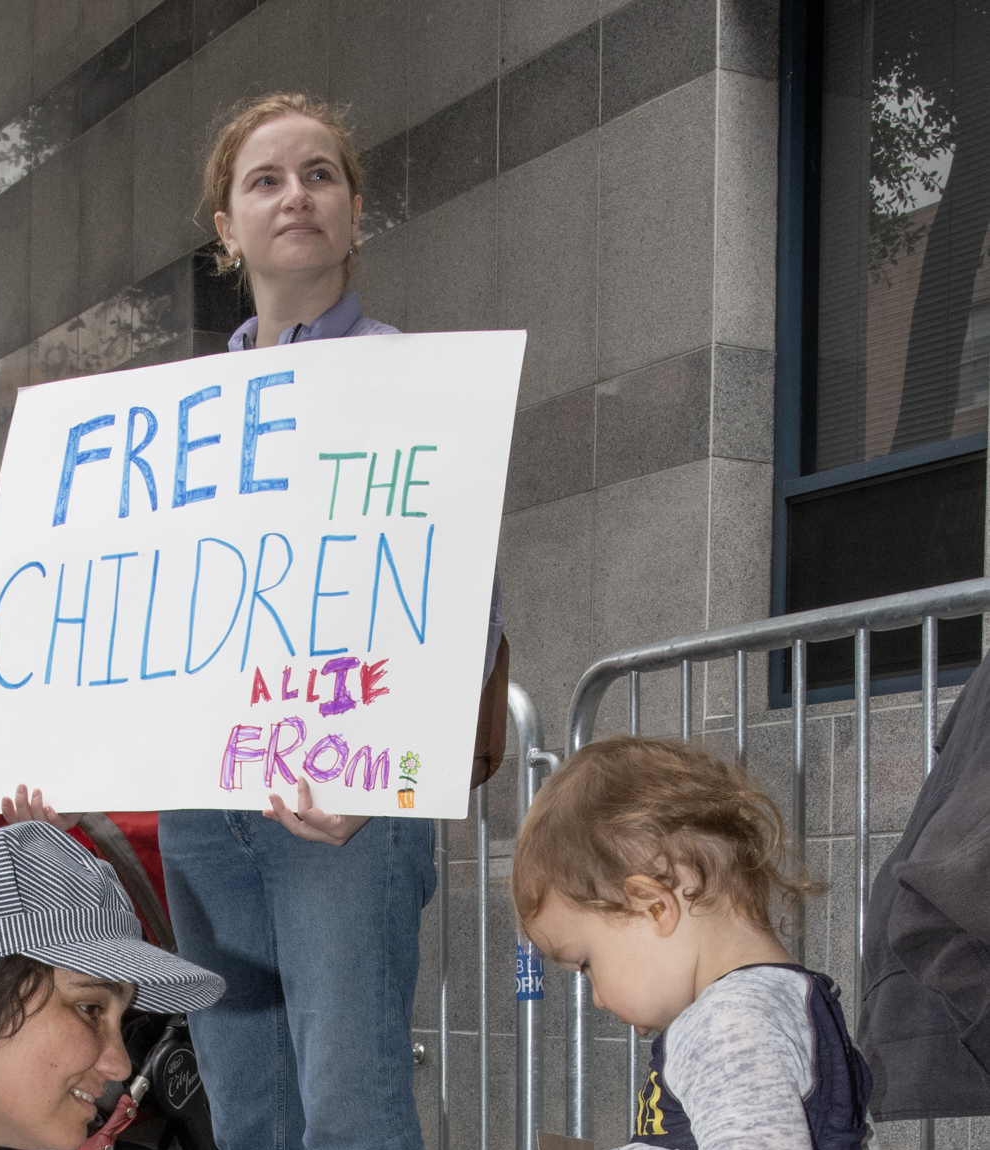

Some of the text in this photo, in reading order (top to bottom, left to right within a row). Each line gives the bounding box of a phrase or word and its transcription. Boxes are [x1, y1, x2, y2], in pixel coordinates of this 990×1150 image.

[52, 370, 438, 527] FREE THE
[250, 656, 391, 718] ALLIE
